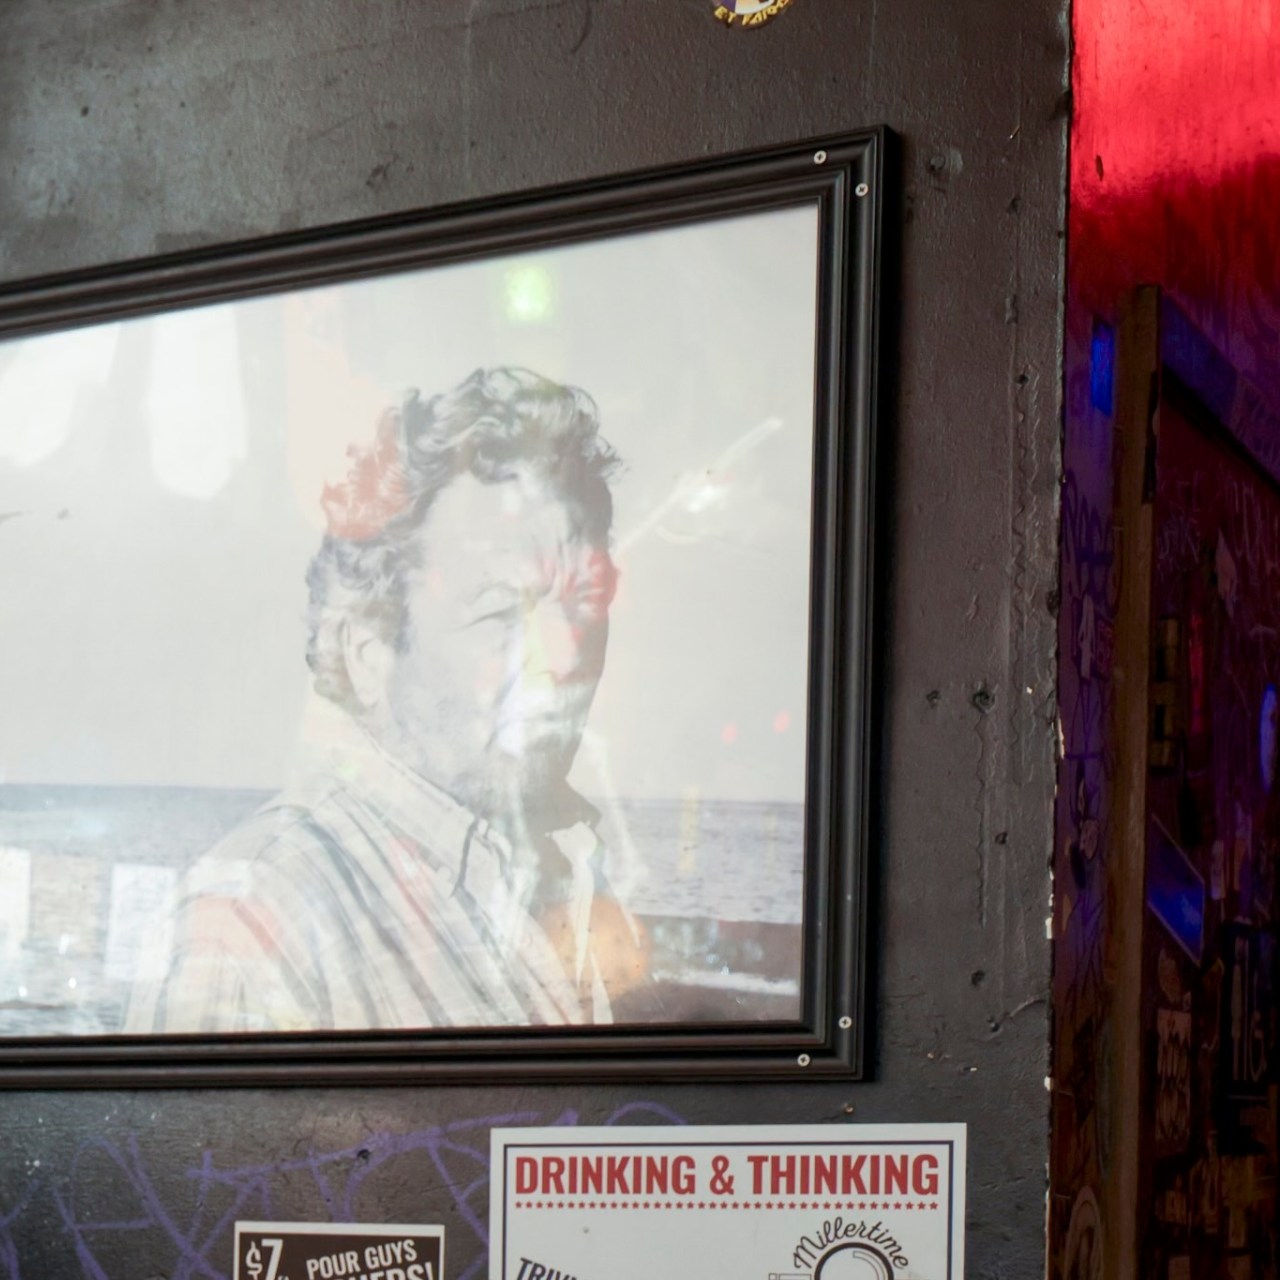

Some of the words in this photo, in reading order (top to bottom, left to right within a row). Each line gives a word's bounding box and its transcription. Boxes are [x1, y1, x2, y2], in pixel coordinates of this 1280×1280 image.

[514, 1155, 696, 1195] DRINKING
[710, 1155, 735, 1195] &
[747, 1154, 939, 1196] THINKING
[306, 1253, 360, 1280] POUR
[365, 1239, 417, 1268] GUYS
[793, 1217, 908, 1269] Millertime
